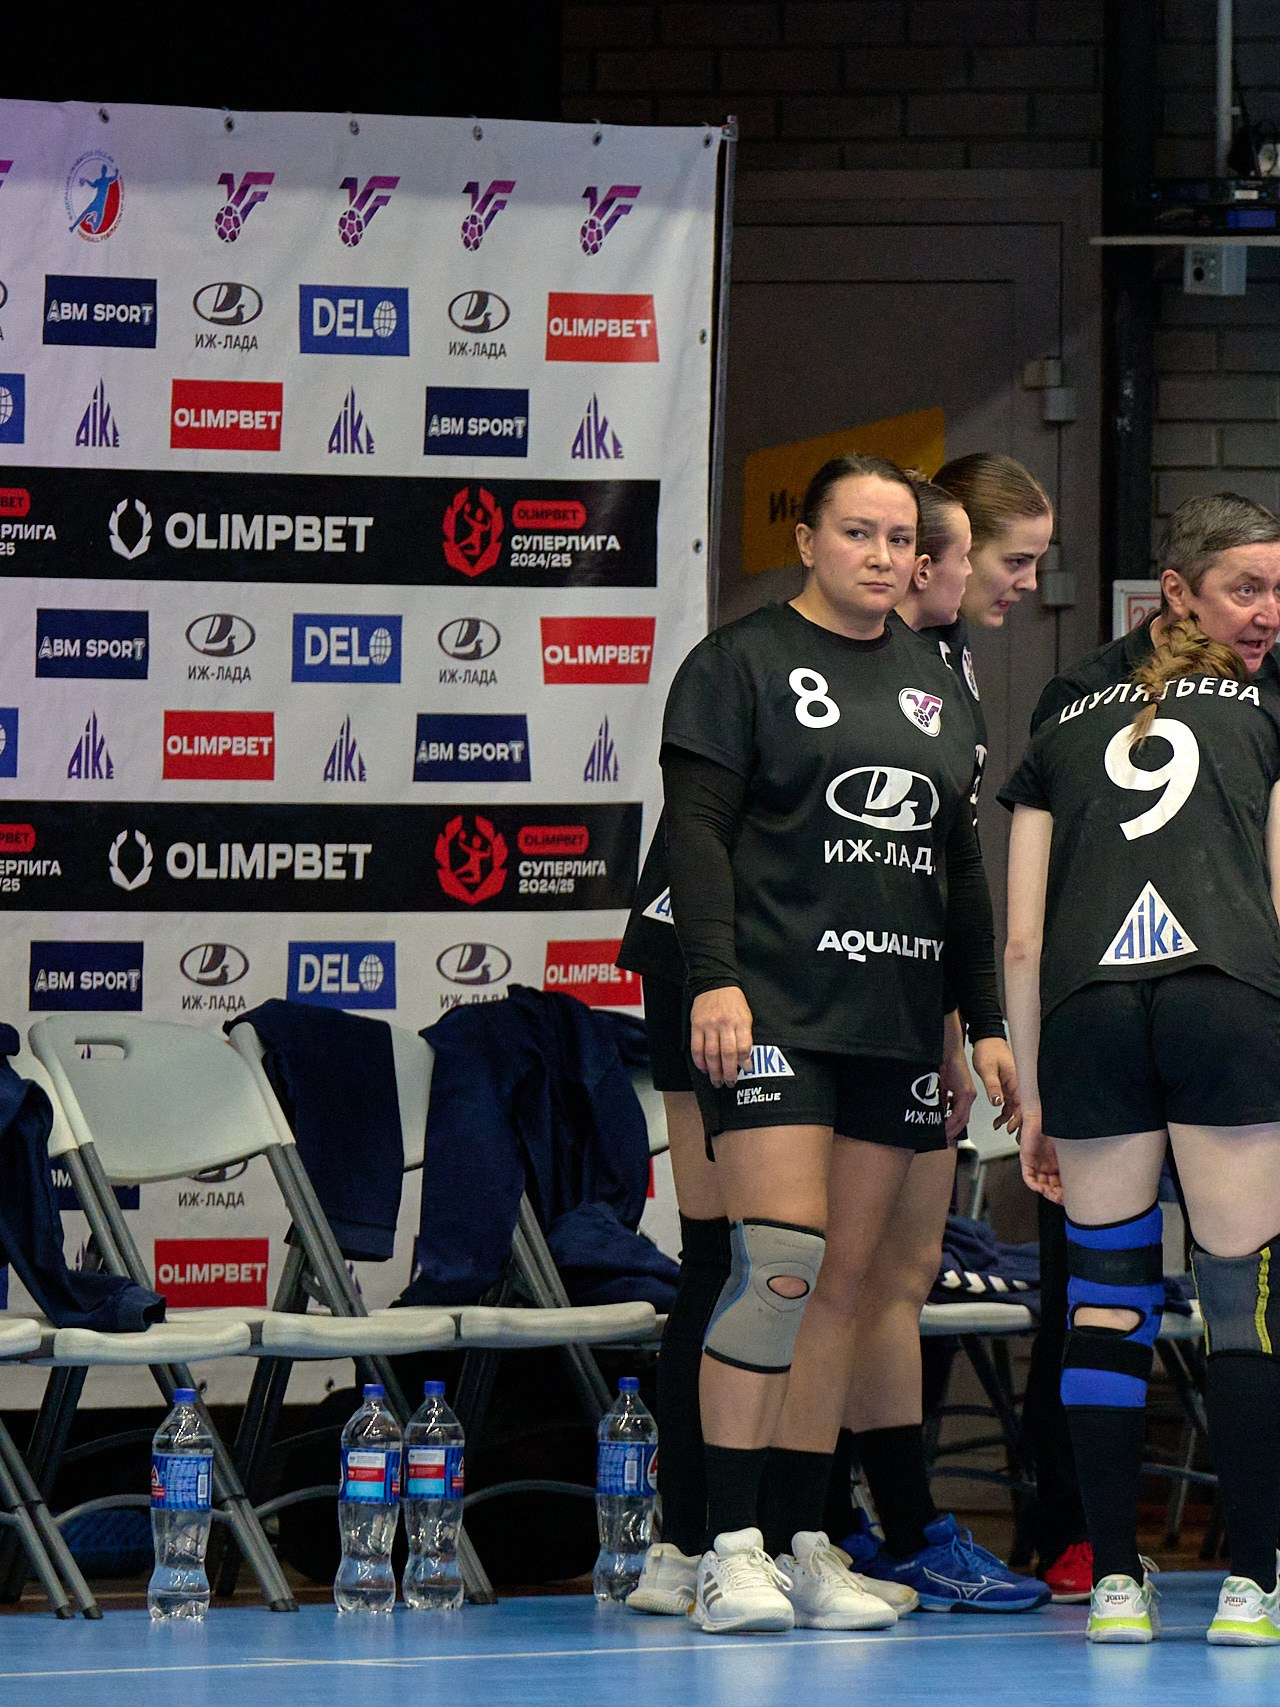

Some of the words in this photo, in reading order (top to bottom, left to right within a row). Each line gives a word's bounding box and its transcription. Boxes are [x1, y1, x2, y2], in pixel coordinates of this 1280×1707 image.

[47, 300, 88, 323] ABM
[93, 302, 153, 325] SPORT
[312, 297, 397, 338] DELO
[549, 316, 652, 338] OLIMPBET
[195, 333, 259, 352] ИЖ-ЛАДА
[448, 341, 507, 359] ИЖ-ЛАДА
[173, 406, 281, 430] OLIMPBET
[428, 414, 464, 437] ABM
[467, 416, 527, 439] SPORT
[517, 508, 580, 521] OLIMPBET
[0, 523, 57, 541] РЛИГА
[164, 511, 375, 553] OLIMPBET
[510, 534, 621, 552] СУПЕРЛИГА
[510, 552, 573, 569] 2024/25
[38, 635, 82, 659] ABM
[85, 636, 146, 661] SPORT
[304, 626, 393, 666] DELO
[544, 644, 651, 665] OLIMPBET
[187, 664, 252, 683] ИЖ-ЛАДА
[438, 667, 498, 685] ИЖ-ЛАДА
[788, 667, 841, 729] 8
[166, 735, 273, 757] OLIMPBET
[415, 740, 454, 763] ABM
[457, 739, 526, 763] SPORT
[1103, 717, 1201, 841] 9
[0, 859, 62, 877] ЕРЛИГА
[165, 841, 373, 881] OLIMPBET
[824, 839, 936, 876] ИЖ-ЛАД
[517, 860, 608, 878] СУПЕРЛИГА
[517, 877, 576, 895] 2024/25
[817, 930, 944, 962] AQUALITY
[33, 968, 75, 992] ABM
[79, 969, 140, 992] SPORT
[297, 953, 385, 994] DELO
[182, 995, 247, 1012] ИЖ-ЛАДА
[737, 1086, 762, 1098] NEW
[737, 1092, 782, 1106] LEAGUE
[178, 1191, 245, 1208] ИЖ-ЛАДА
[158, 1262, 267, 1285] OLIMPBET
